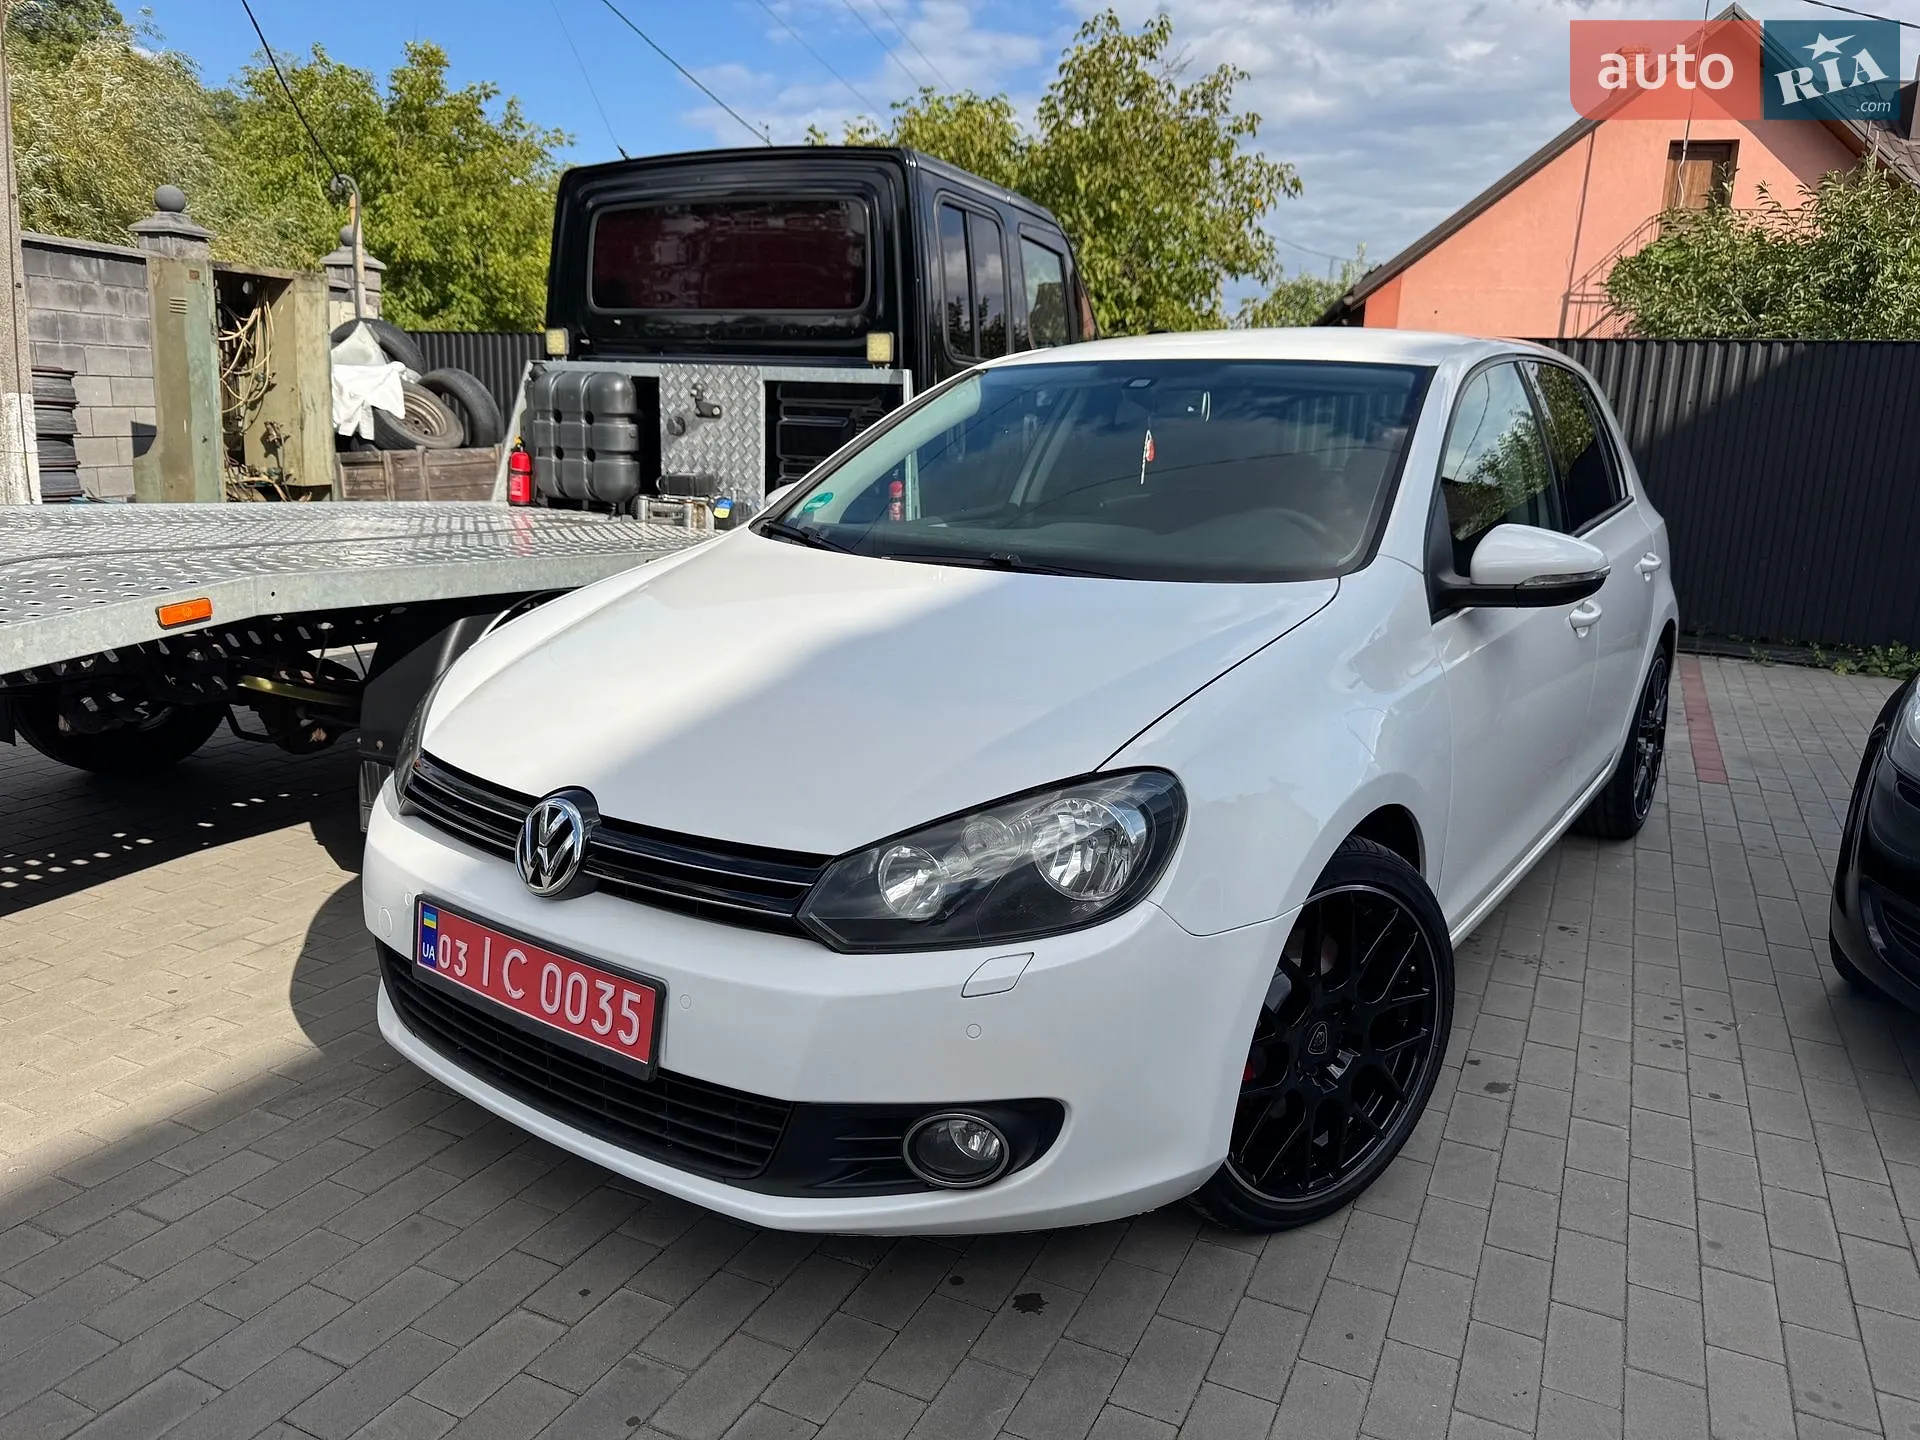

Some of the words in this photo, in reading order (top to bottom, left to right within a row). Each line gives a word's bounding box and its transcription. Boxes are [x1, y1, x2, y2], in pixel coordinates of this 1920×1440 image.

[521, 800, 582, 892] VW
[422, 941, 436, 962] UA
[438, 934, 468, 977] 03
[482, 936, 528, 1000] IC
[540, 962, 641, 1046] 0035
